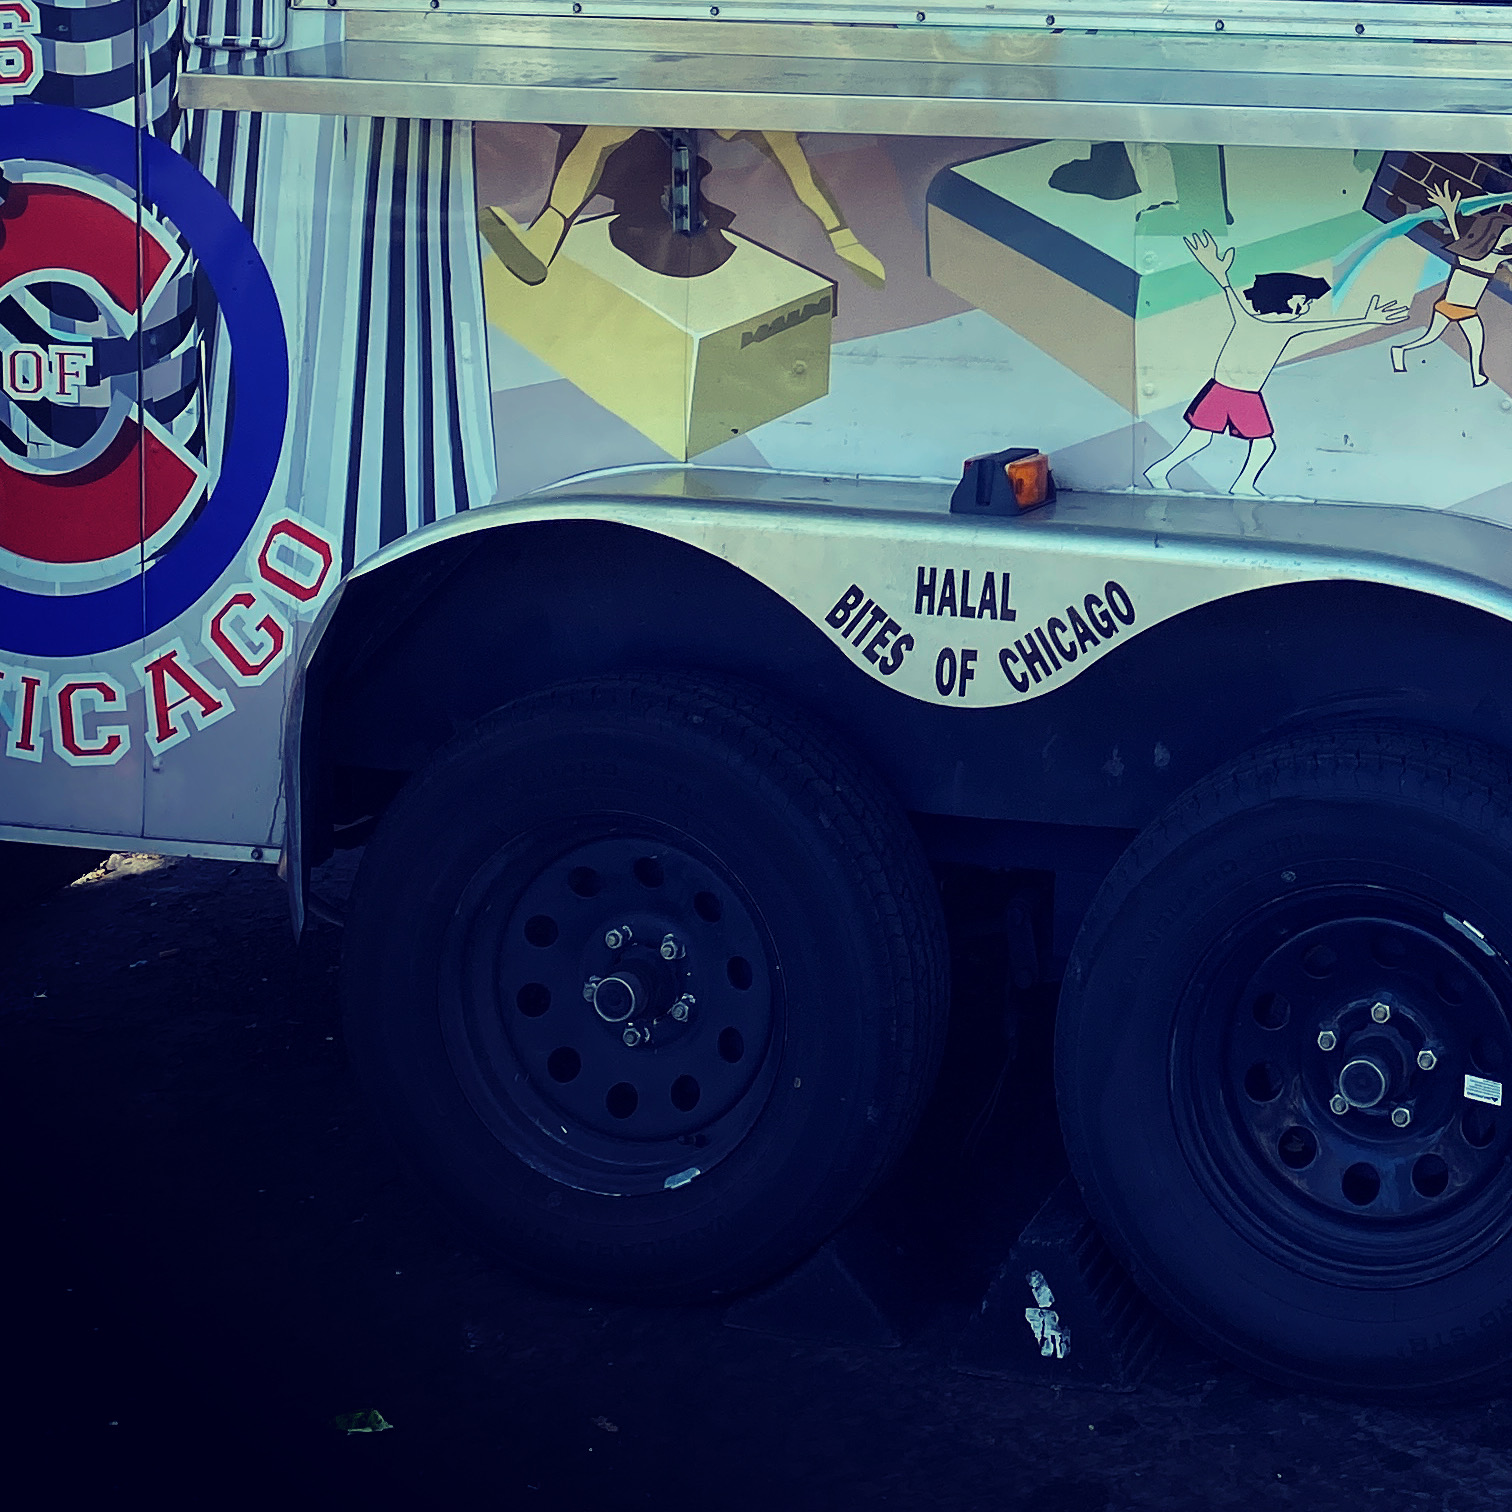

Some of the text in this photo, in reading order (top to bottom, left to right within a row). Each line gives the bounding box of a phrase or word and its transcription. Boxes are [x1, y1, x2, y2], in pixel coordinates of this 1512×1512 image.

[7, 347, 89, 399] OF
[0, 506, 342, 768] ICAGO
[914, 566, 1018, 622] HALAL
[824, 580, 1136, 698] BITES OF CHICAGO
